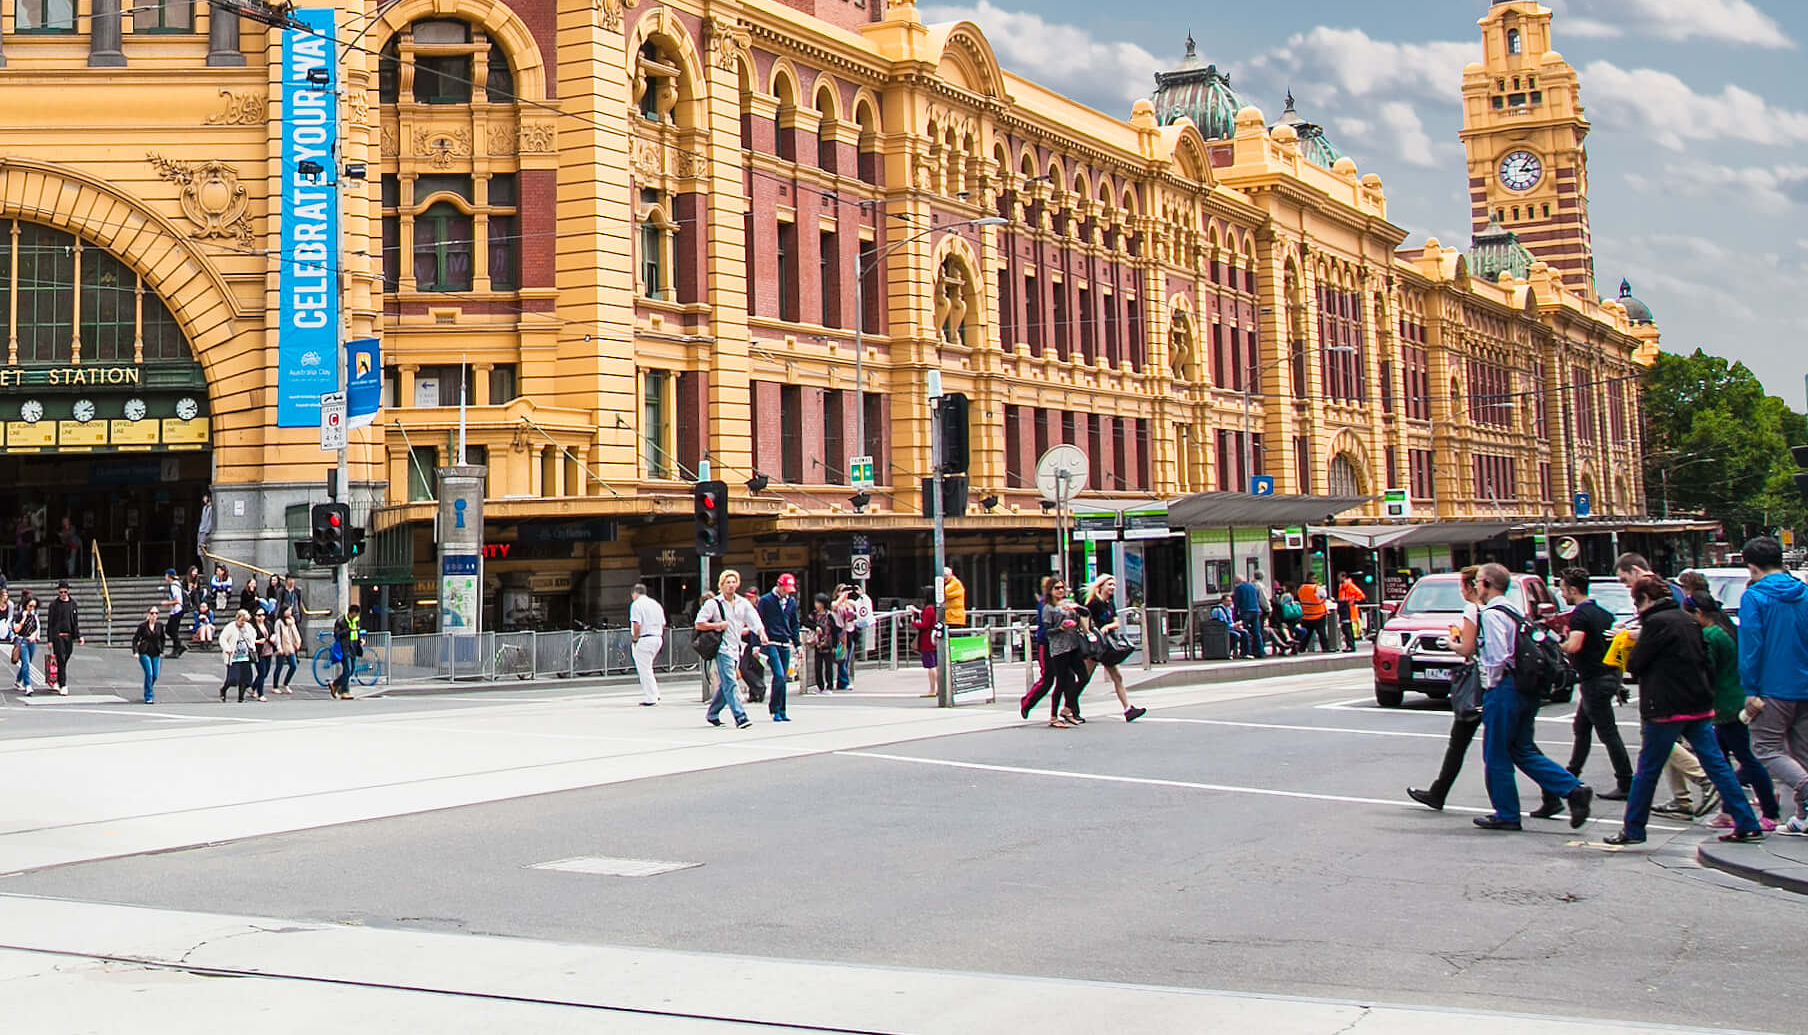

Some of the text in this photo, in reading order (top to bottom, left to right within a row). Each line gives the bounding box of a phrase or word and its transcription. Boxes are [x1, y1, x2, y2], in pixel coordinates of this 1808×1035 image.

[292, 28, 328, 329] CELEBRATE YOUR WAY
[48, 367, 140, 386] STATION
[854, 562, 868, 571] 40
